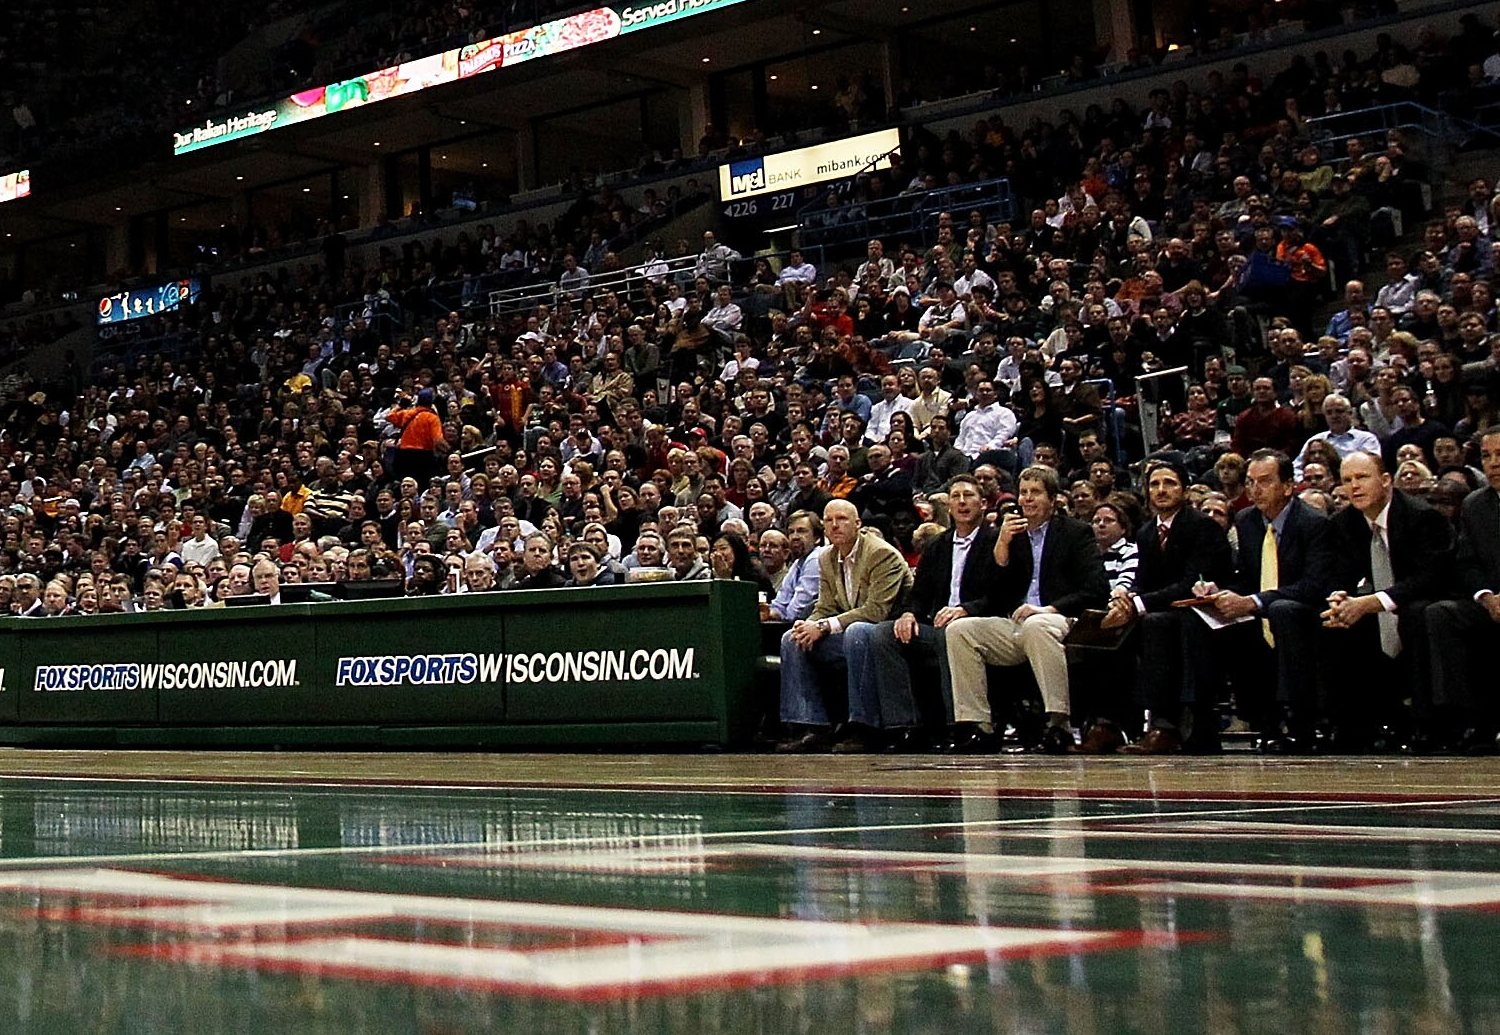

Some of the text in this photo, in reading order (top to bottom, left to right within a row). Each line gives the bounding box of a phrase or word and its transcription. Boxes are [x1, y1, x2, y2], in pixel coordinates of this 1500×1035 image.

[503, 38, 537, 59] PIZZA
[227, 109, 278, 131] Heritage
[768, 168, 802, 185] BANK
[734, 201, 758, 217] 226
[771, 192, 796, 211] 227
